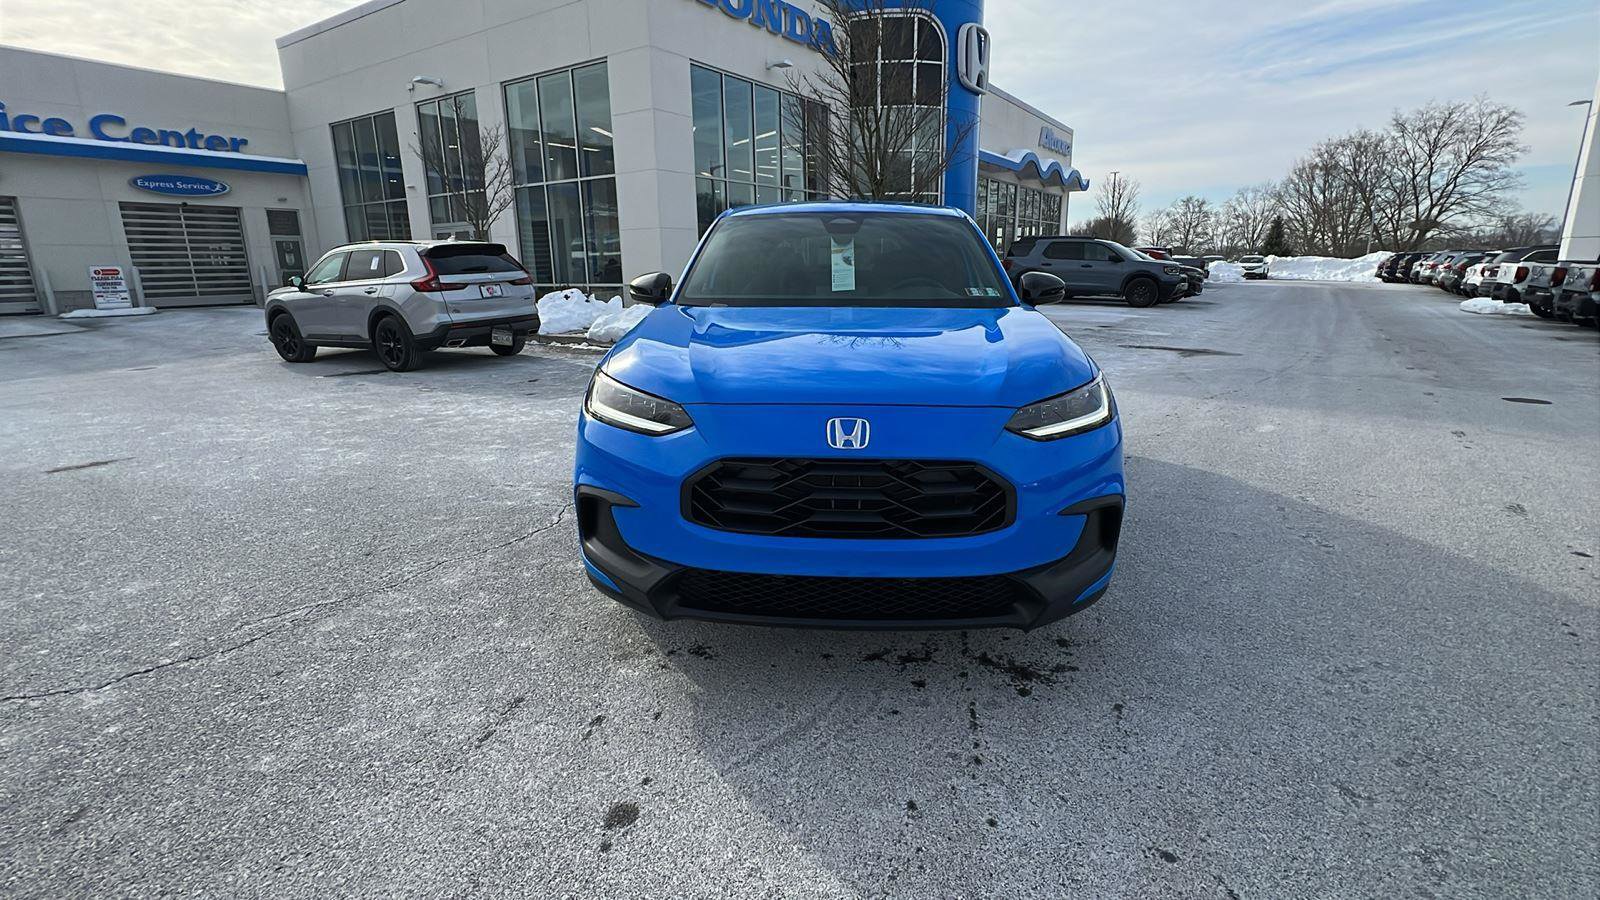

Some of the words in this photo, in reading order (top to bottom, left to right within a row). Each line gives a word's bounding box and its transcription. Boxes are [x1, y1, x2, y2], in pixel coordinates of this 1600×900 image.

[89, 114, 249, 154] Center
[137, 179, 174, 189] Express
[177, 181, 210, 190] Service
